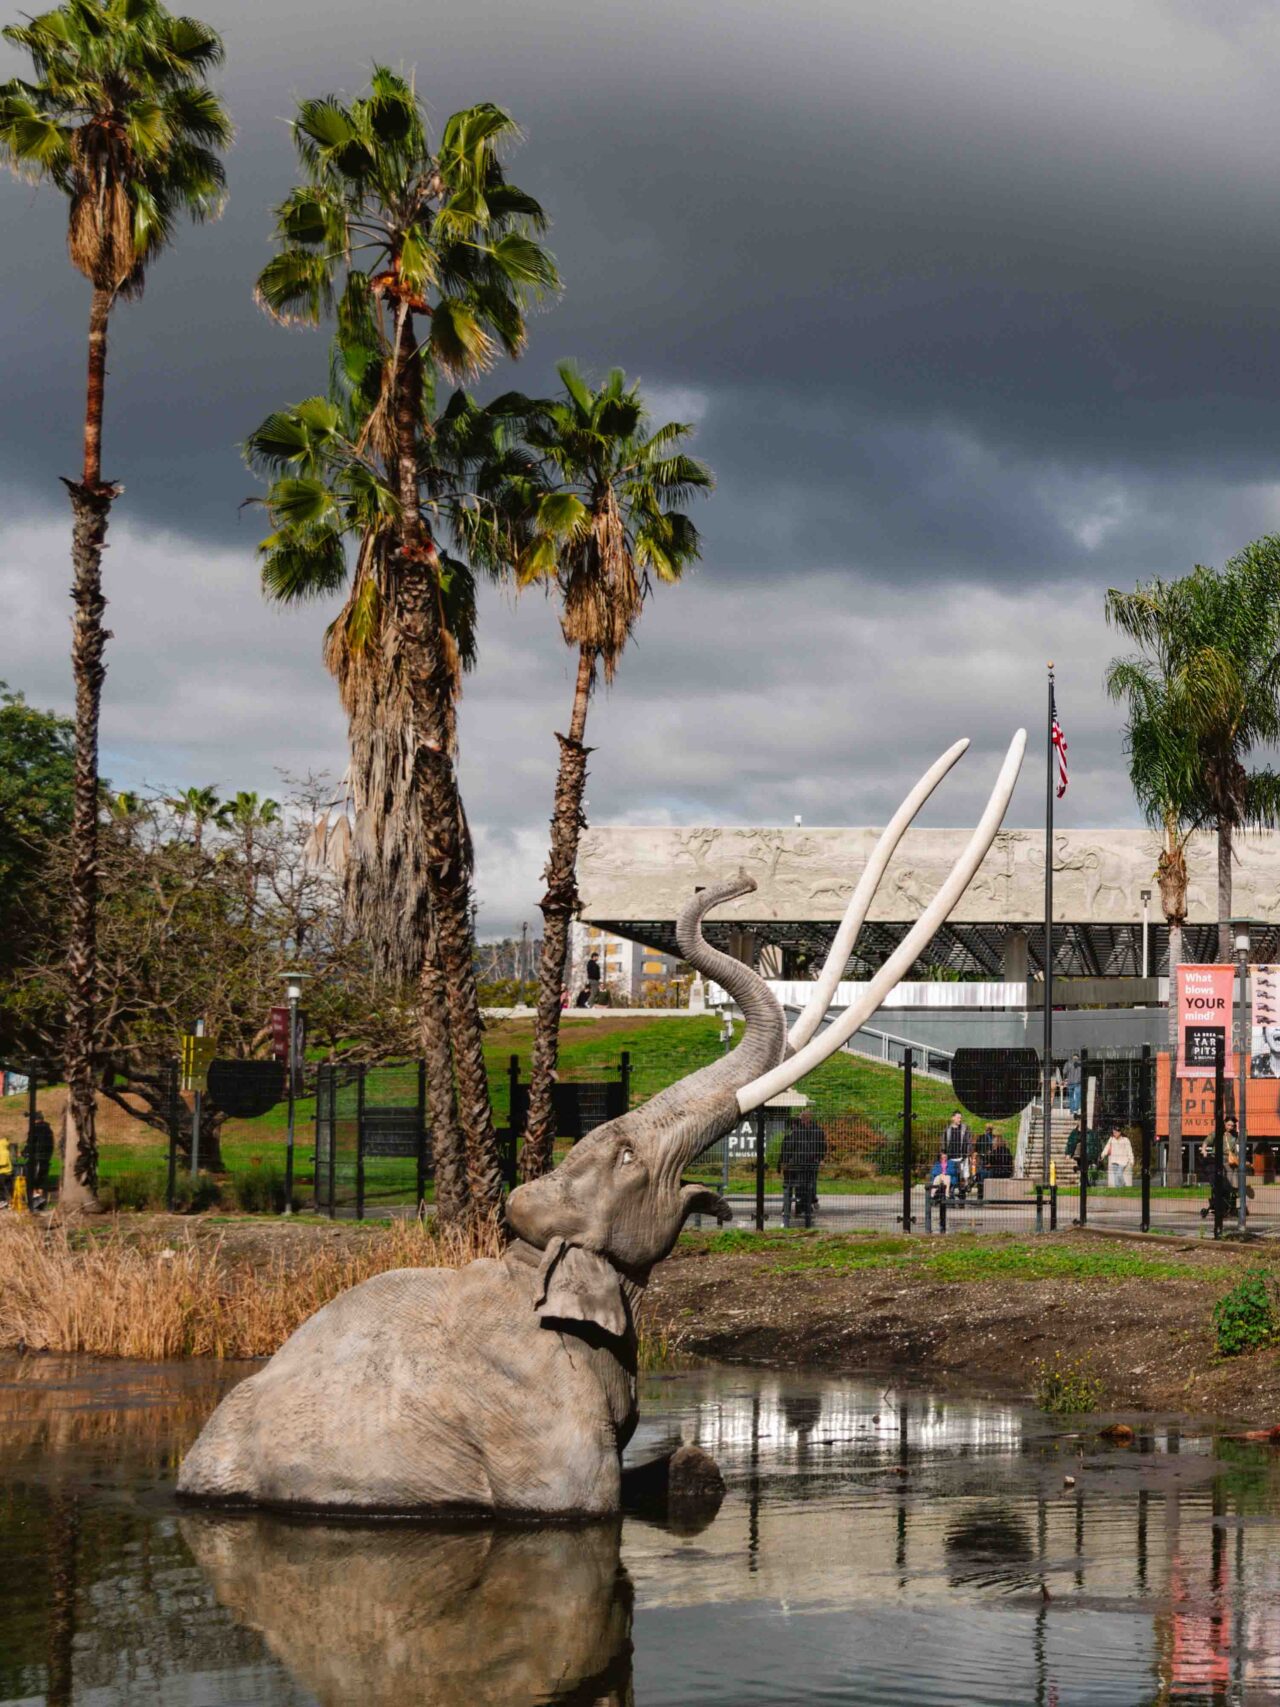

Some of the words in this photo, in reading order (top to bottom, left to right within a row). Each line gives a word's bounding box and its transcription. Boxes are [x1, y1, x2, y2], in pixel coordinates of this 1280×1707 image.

[1185, 973, 1212, 982] What
[1185, 986, 1214, 995] blows
[1186, 998, 1225, 1009] YOUR
[1185, 1011, 1215, 1021] mind?
[1193, 1038, 1216, 1046] TAR
[1193, 1047, 1217, 1056] PITS
[1186, 1078, 1216, 1094] TA
[728, 1136, 766, 1149] PIT
